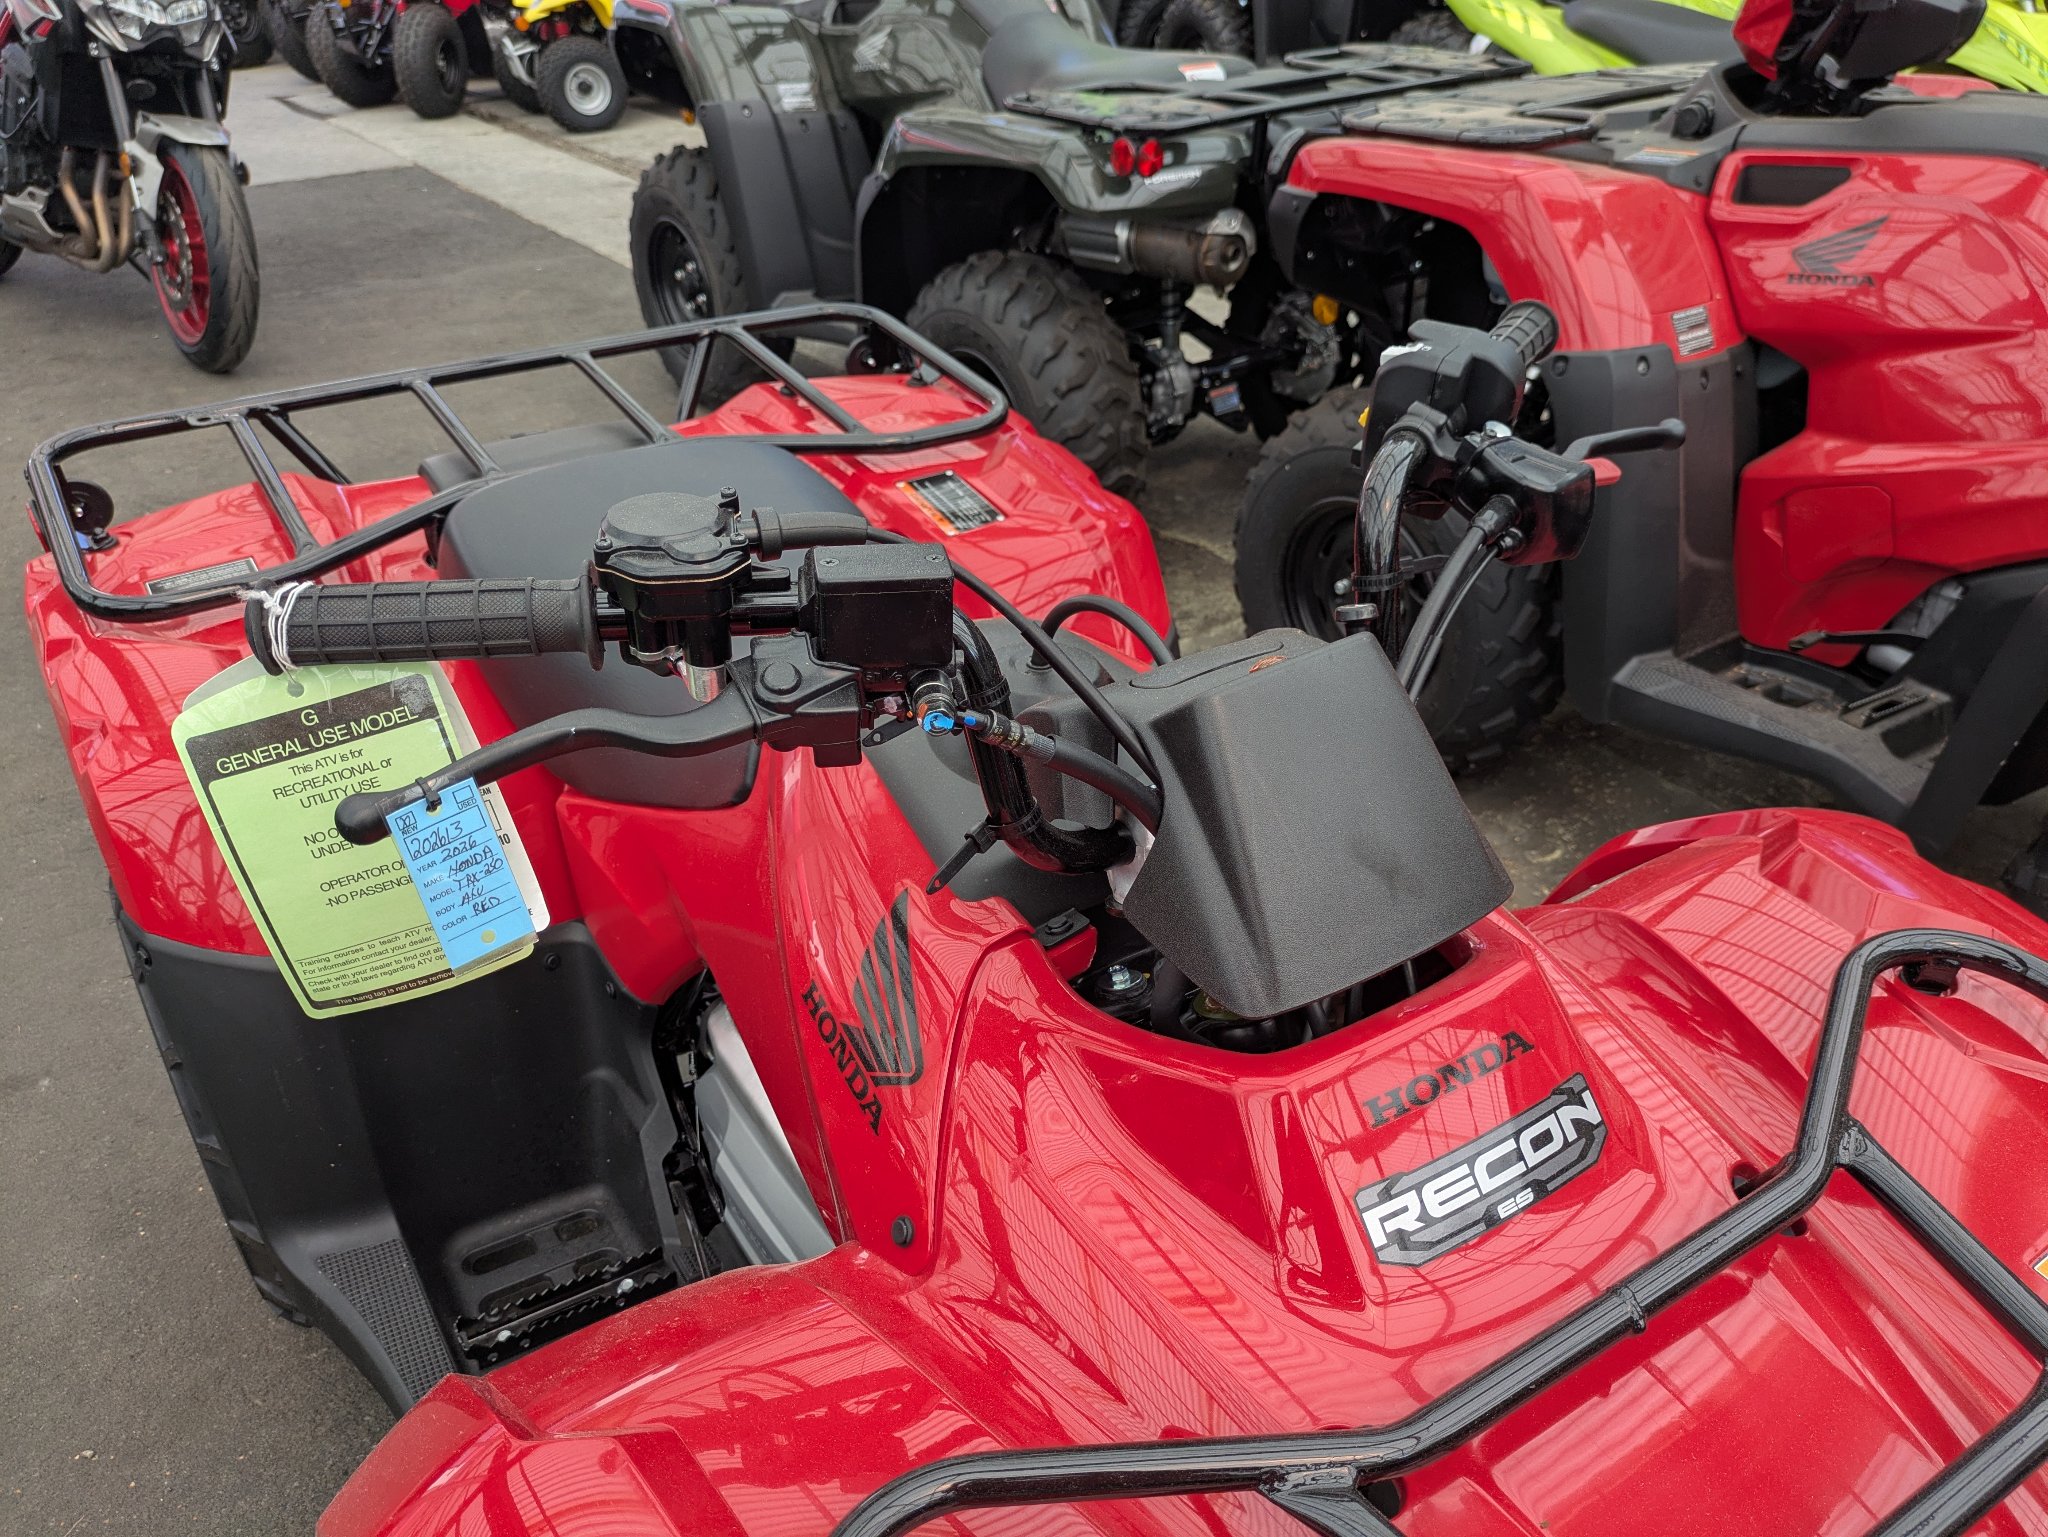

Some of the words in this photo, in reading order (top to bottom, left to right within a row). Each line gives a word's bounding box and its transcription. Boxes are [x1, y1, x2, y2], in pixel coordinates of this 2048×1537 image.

[1788, 274, 1875, 288] HONDA
[301, 709, 319, 726] G
[216, 738, 310, 774] GENERAL
[309, 724, 351, 748] USE
[350, 705, 419, 737] MODEL
[288, 762, 313, 777] This
[315, 756, 339, 770] ATV
[339, 752, 350, 763] is
[349, 748, 364, 760] for
[272, 762, 379, 800] RECREATIONAL
[380, 757, 393, 768] or
[299, 783, 349, 809] UTILITY
[351, 776, 381, 794] USE
[457, 798, 477, 811] USED
[304, 831, 326, 846] NO
[401, 824, 419, 837] NEW
[410, 820, 463, 860] 202613
[441, 835, 477, 862] 2026
[448, 845, 494, 879] HONDA
[320, 864, 391, 892] OPERATOR
[416, 861, 438, 874] YEAR
[423, 875, 444, 888] MAKE
[350, 875, 413, 901] PASSENG
[429, 887, 455, 903] MODEL
[435, 903, 456, 917] BODY
[472, 896, 501, 917] RED
[441, 915, 468, 931] COLOR
[300, 955, 331, 968] Training
[334, 947, 364, 960] courses
[378, 936, 401, 946] teach
[404, 929, 421, 939] ATV
[317, 957, 361, 973] information
[361, 950, 389, 962] contact
[390, 944, 408, 954] your
[408, 935, 435, 948] dealer.
[308, 975, 333, 988] Check
[333, 972, 350, 983] with
[351, 968, 368, 979] your
[369, 961, 394, 973] dealer
[403, 953, 418, 963] find
[419, 949, 432, 959] out
[312, 985, 331, 994] state
[341, 977, 360, 987] local
[361, 973, 379, 983] laws
[379, 962, 416, 980] regarding
[417, 956, 434, 967] ATV
[336, 997, 353, 1006] This
[353, 992, 374, 1003] hang
[374, 988, 387, 998] tag
[395, 984, 408, 992] not
[408, 981, 417, 989] to
[418, 978, 429, 986] be
[429, 971, 456, 983] remov
[800, 979, 884, 1137] HONDA
[1363, 1030, 1535, 1128] HONDA
[1361, 1090, 1602, 1248] RECON
[1498, 1188, 1535, 1220] ES
